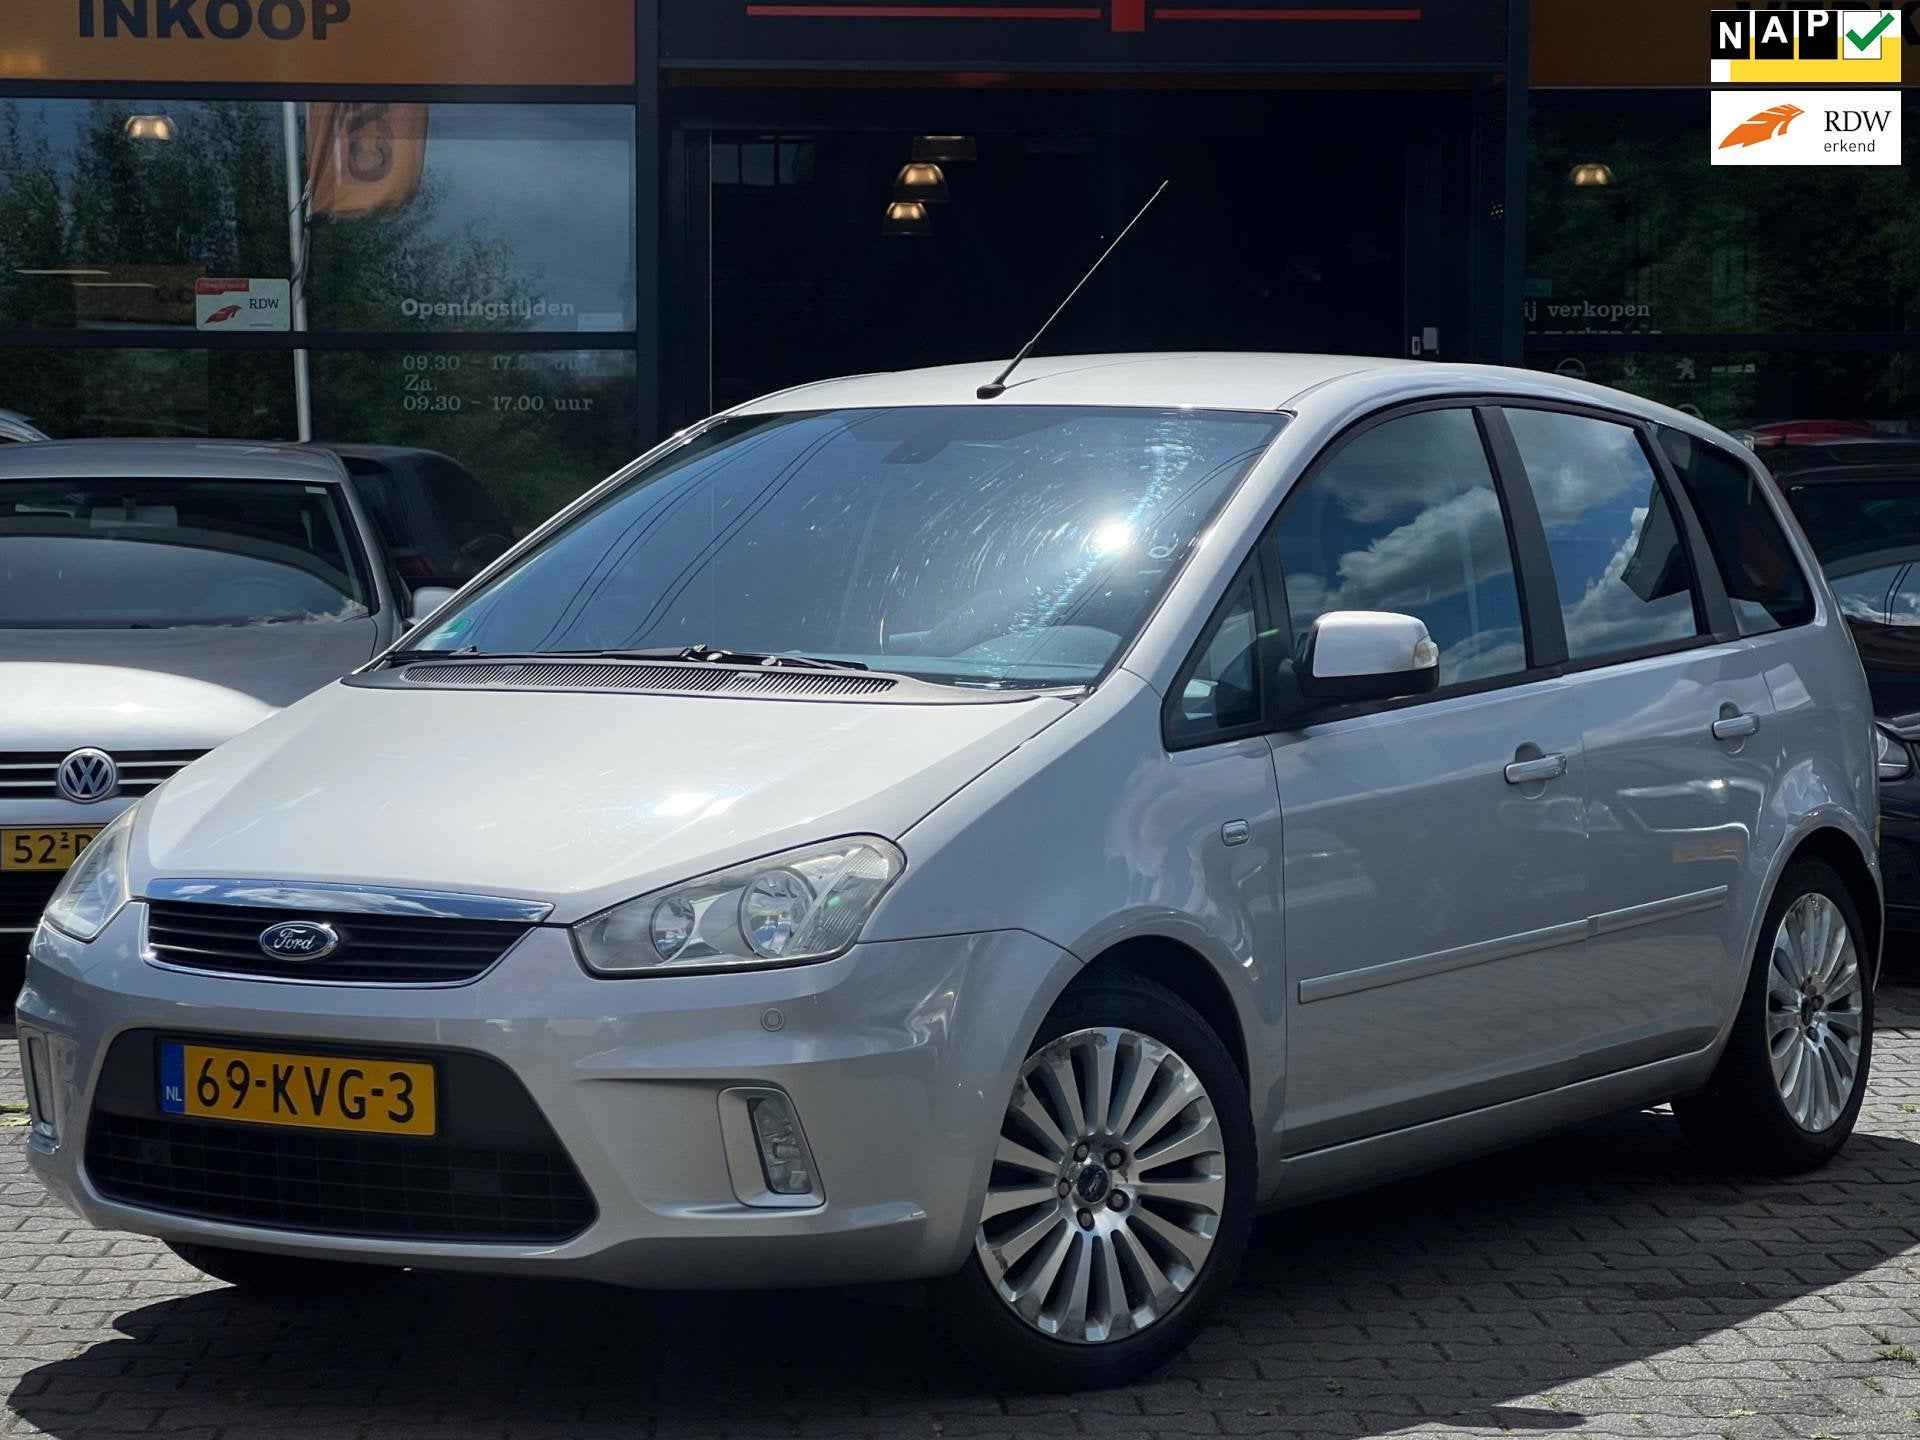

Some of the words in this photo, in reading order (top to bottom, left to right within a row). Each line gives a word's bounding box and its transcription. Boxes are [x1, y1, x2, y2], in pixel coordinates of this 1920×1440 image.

[79, 0, 351, 41] INKOOP
[248, 298, 280, 309] RDW
[401, 298, 576, 321] Openingstijden
[1547, 301, 1651, 321] verkopen
[402, 355, 461, 371] 09.30
[404, 374, 438, 392] Za.
[403, 396, 462, 412] 09.30
[491, 396, 544, 412] 17.00
[554, 397, 594, 411] uur
[273, 927, 316, 950] Ford
[165, 1085, 182, 1102] NL
[197, 1057, 415, 1124] 69-KVG-3
